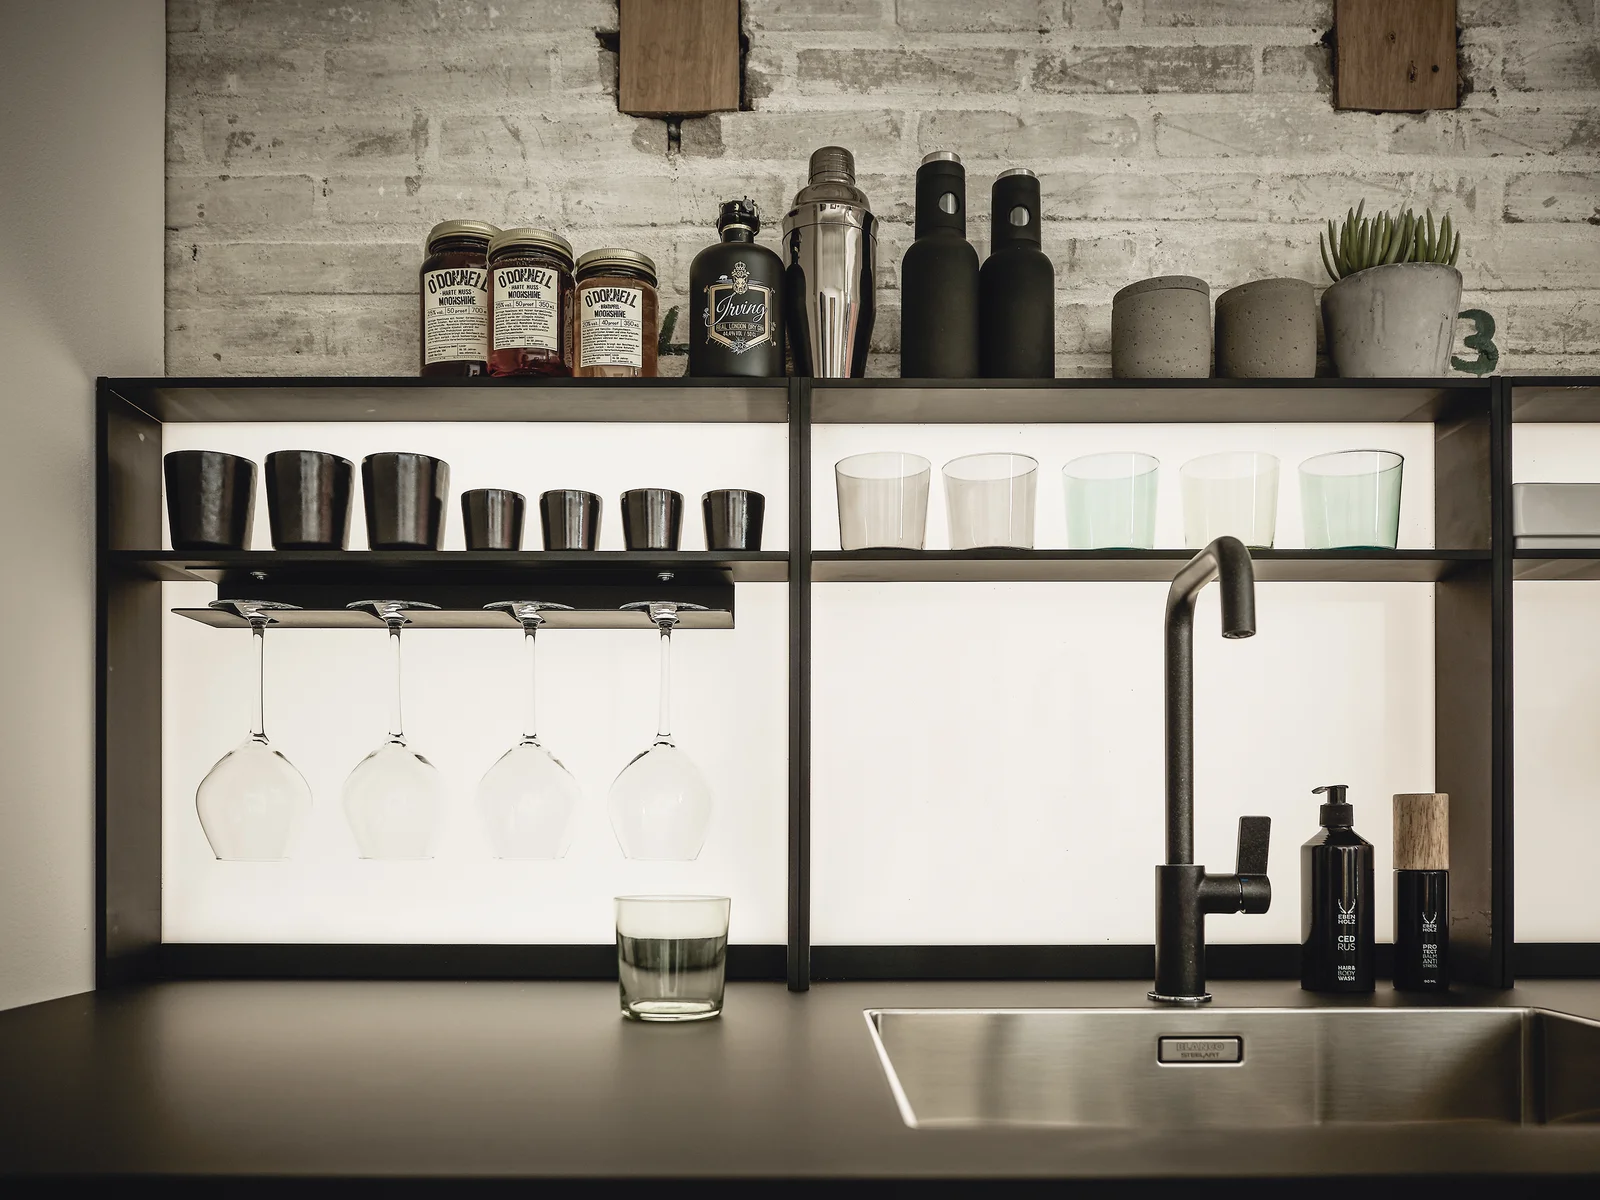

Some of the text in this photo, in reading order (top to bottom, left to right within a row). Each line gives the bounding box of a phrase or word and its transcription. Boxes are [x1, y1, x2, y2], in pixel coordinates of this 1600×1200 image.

[428, 270, 488, 294] O'DONNELL
[498, 268, 553, 289] O'DONNELL
[508, 291, 542, 299] MOONSHINE
[585, 288, 637, 308] O'DONNELL
[439, 296, 476, 306] MOONSHINE
[704, 292, 767, 328] Irving
[728, 322, 748, 331] LONDON
[1450, 308, 1499, 378] 3
[1337, 935, 1356, 943] CED
[1337, 943, 1356, 951] RUS
[1176, 1042, 1225, 1052] BLANCO
